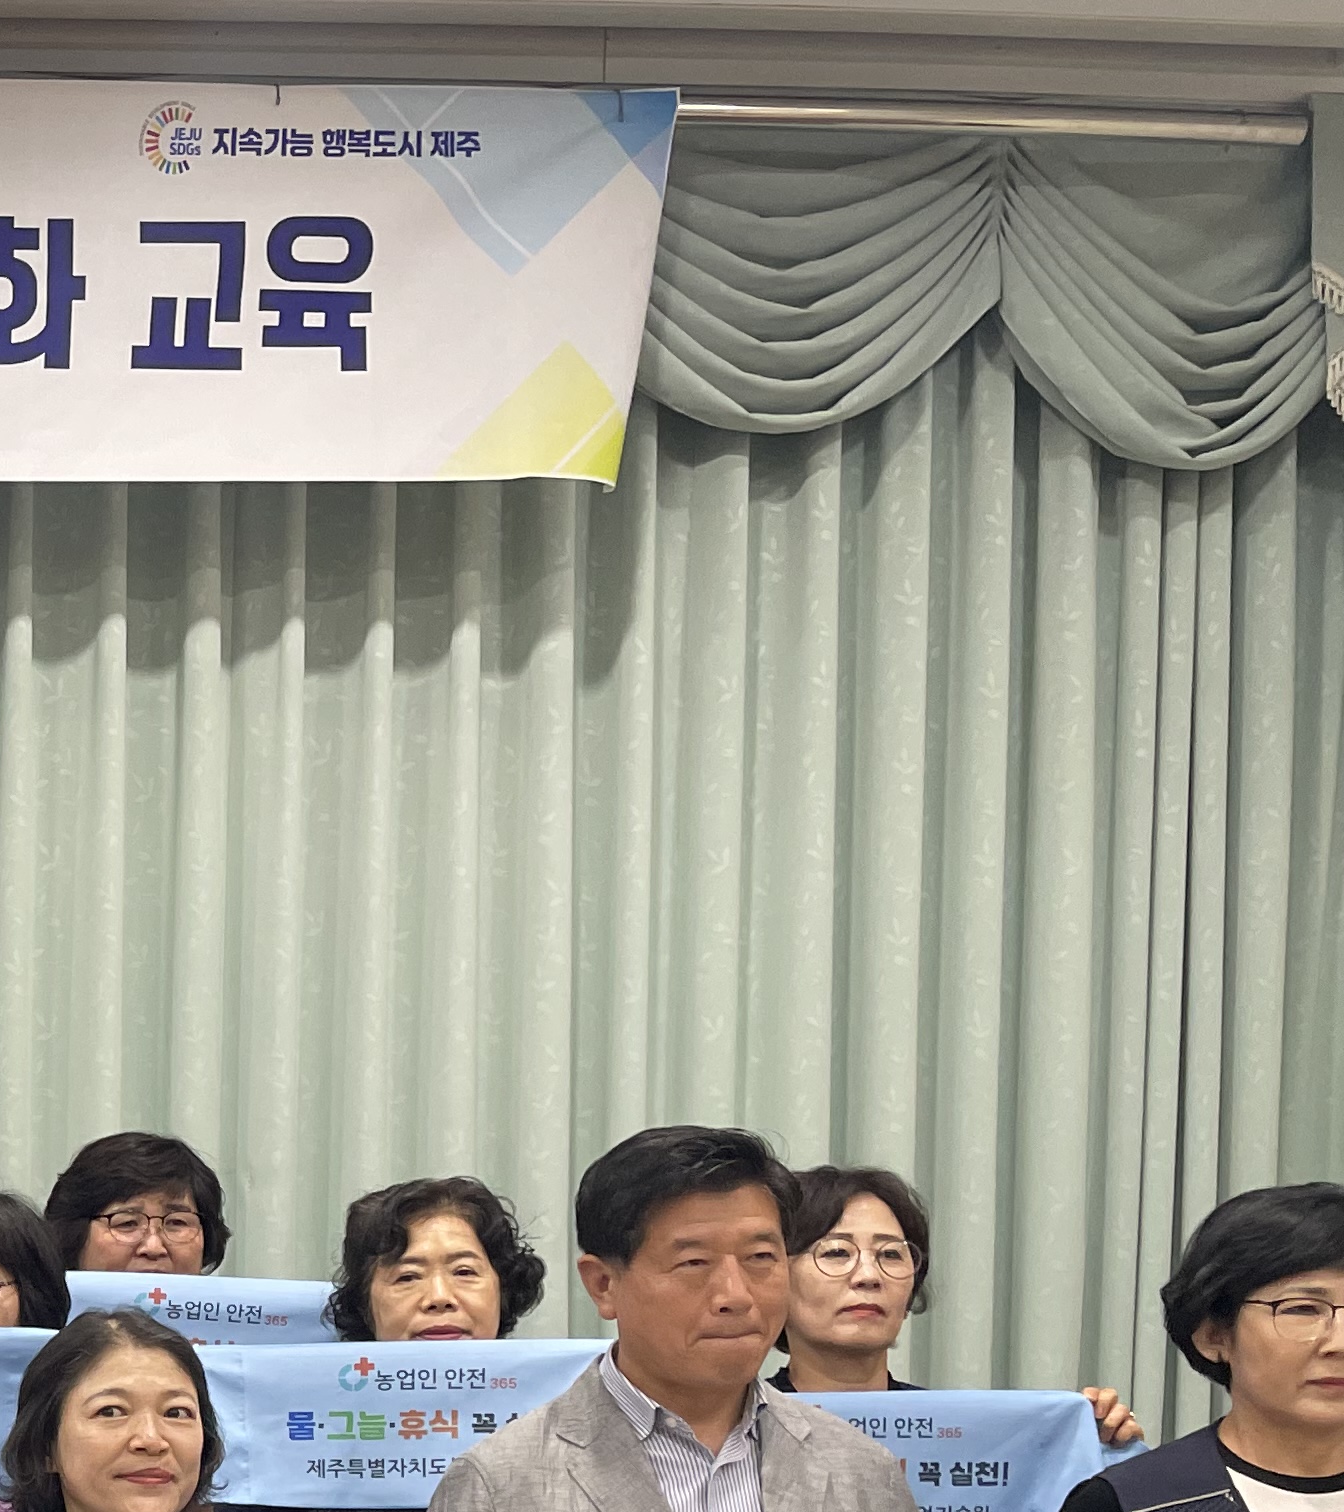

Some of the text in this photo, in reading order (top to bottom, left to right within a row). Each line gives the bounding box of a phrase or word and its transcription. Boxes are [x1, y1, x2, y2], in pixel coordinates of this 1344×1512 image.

[171, 128, 202, 141] JEJU
[212, 127, 314, 157] 지속가능
[322, 129, 422, 157] 행복도시
[430, 131, 481, 158] 제주
[170, 143, 201, 155] SDGs
[131, 214, 374, 374] 교육
[165, 1299, 219, 1321] 농업인
[375, 1368, 437, 1391] 농업인
[472, 1413, 497, 1434] 꼭
[306, 1458, 455, 1479] 제주특별자치도
[918, 1462, 942, 1486] 꼭
[950, 1461, 1009, 1487] 실천!
